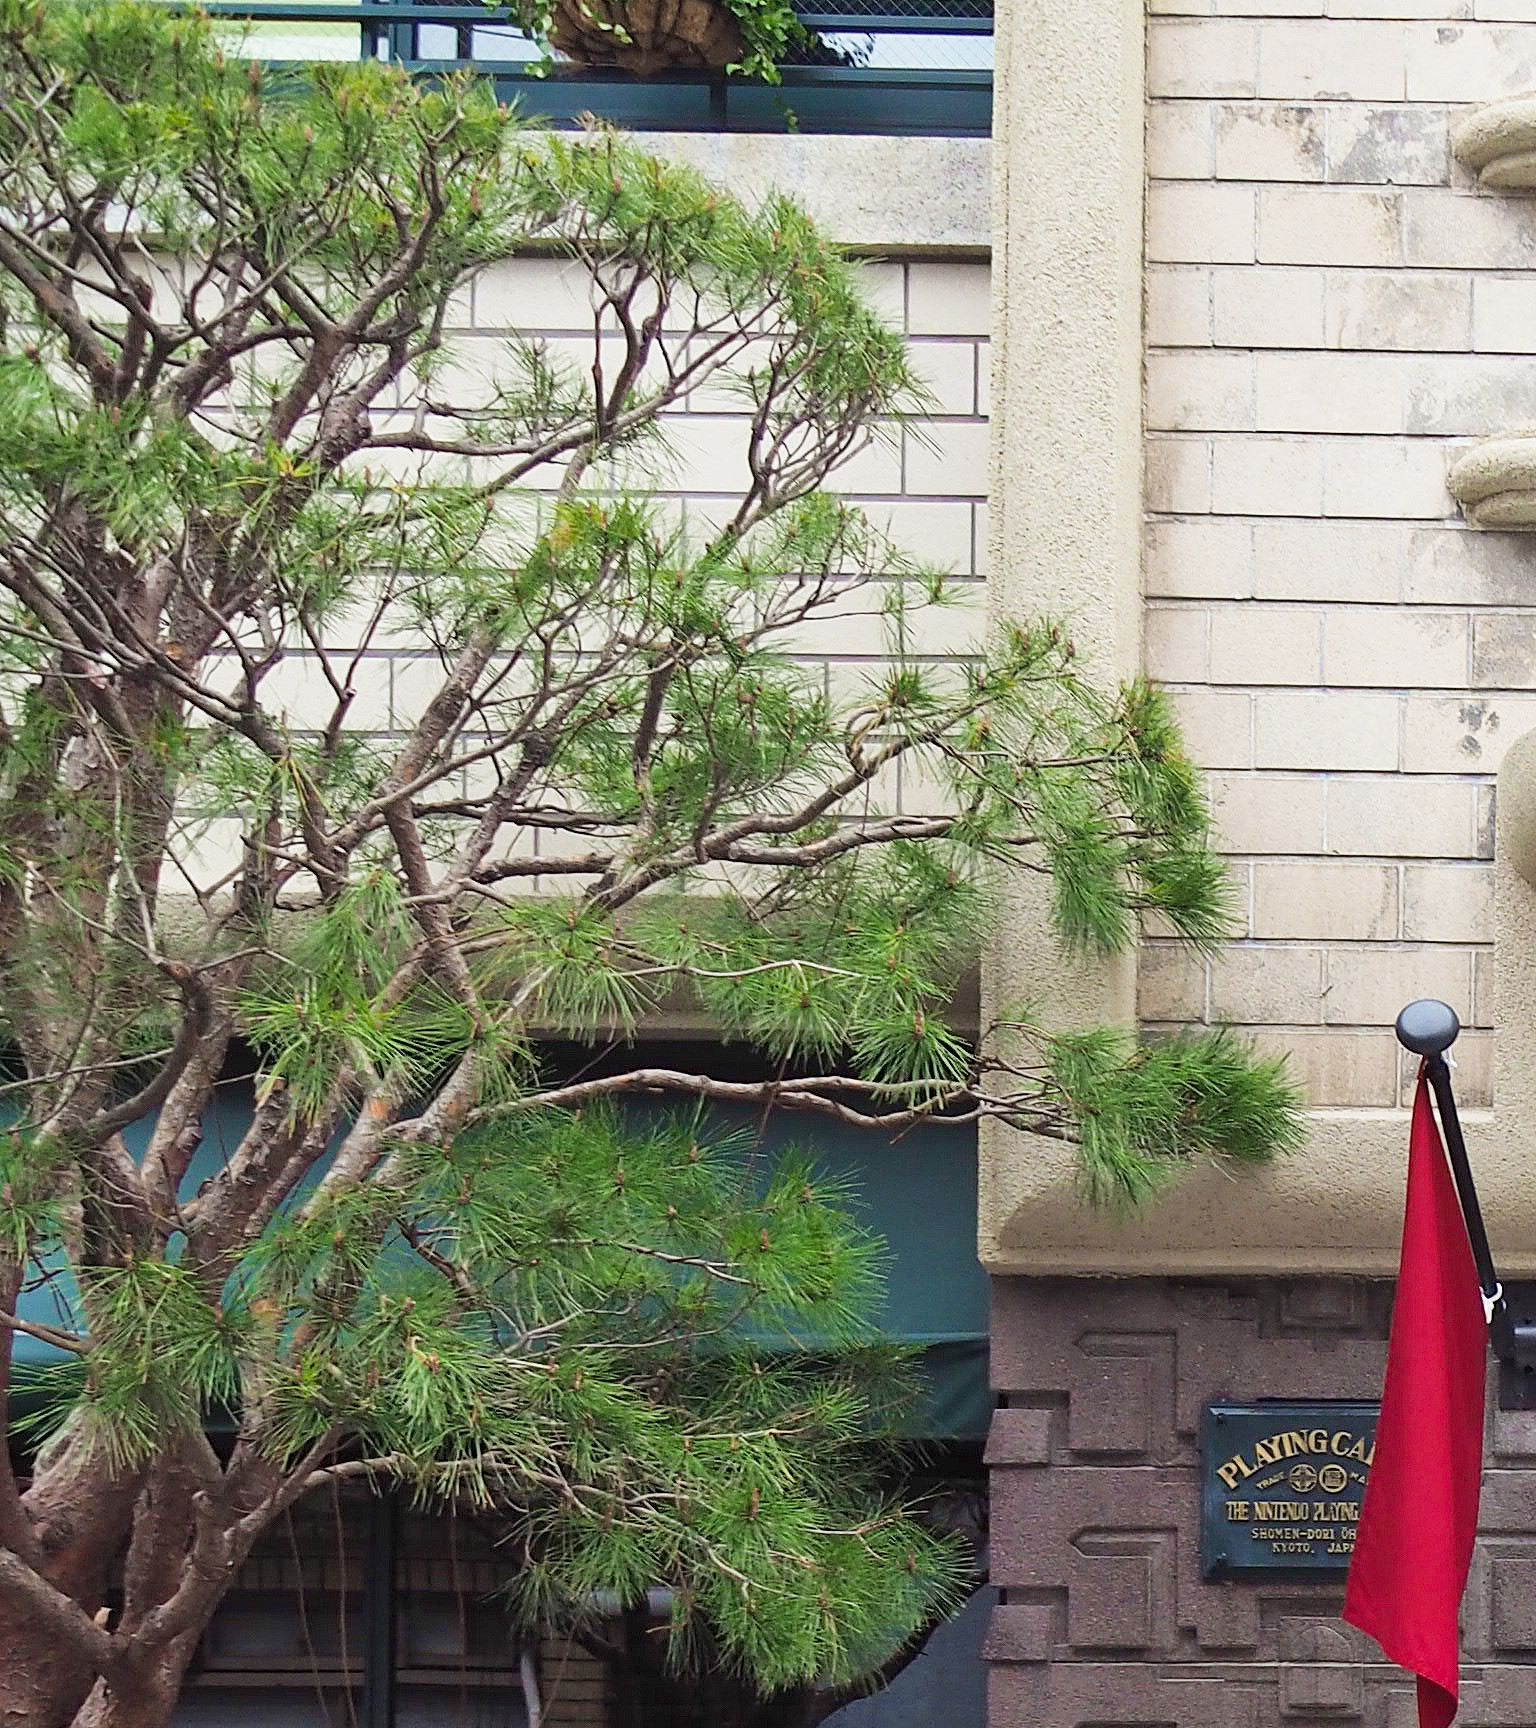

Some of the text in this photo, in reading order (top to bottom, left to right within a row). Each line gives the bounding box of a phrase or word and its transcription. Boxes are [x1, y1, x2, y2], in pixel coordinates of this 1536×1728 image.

[1216, 1429, 1328, 1489] PLAYING
[1225, 1501, 1360, 1522] THE NINTENDO PLAYING
